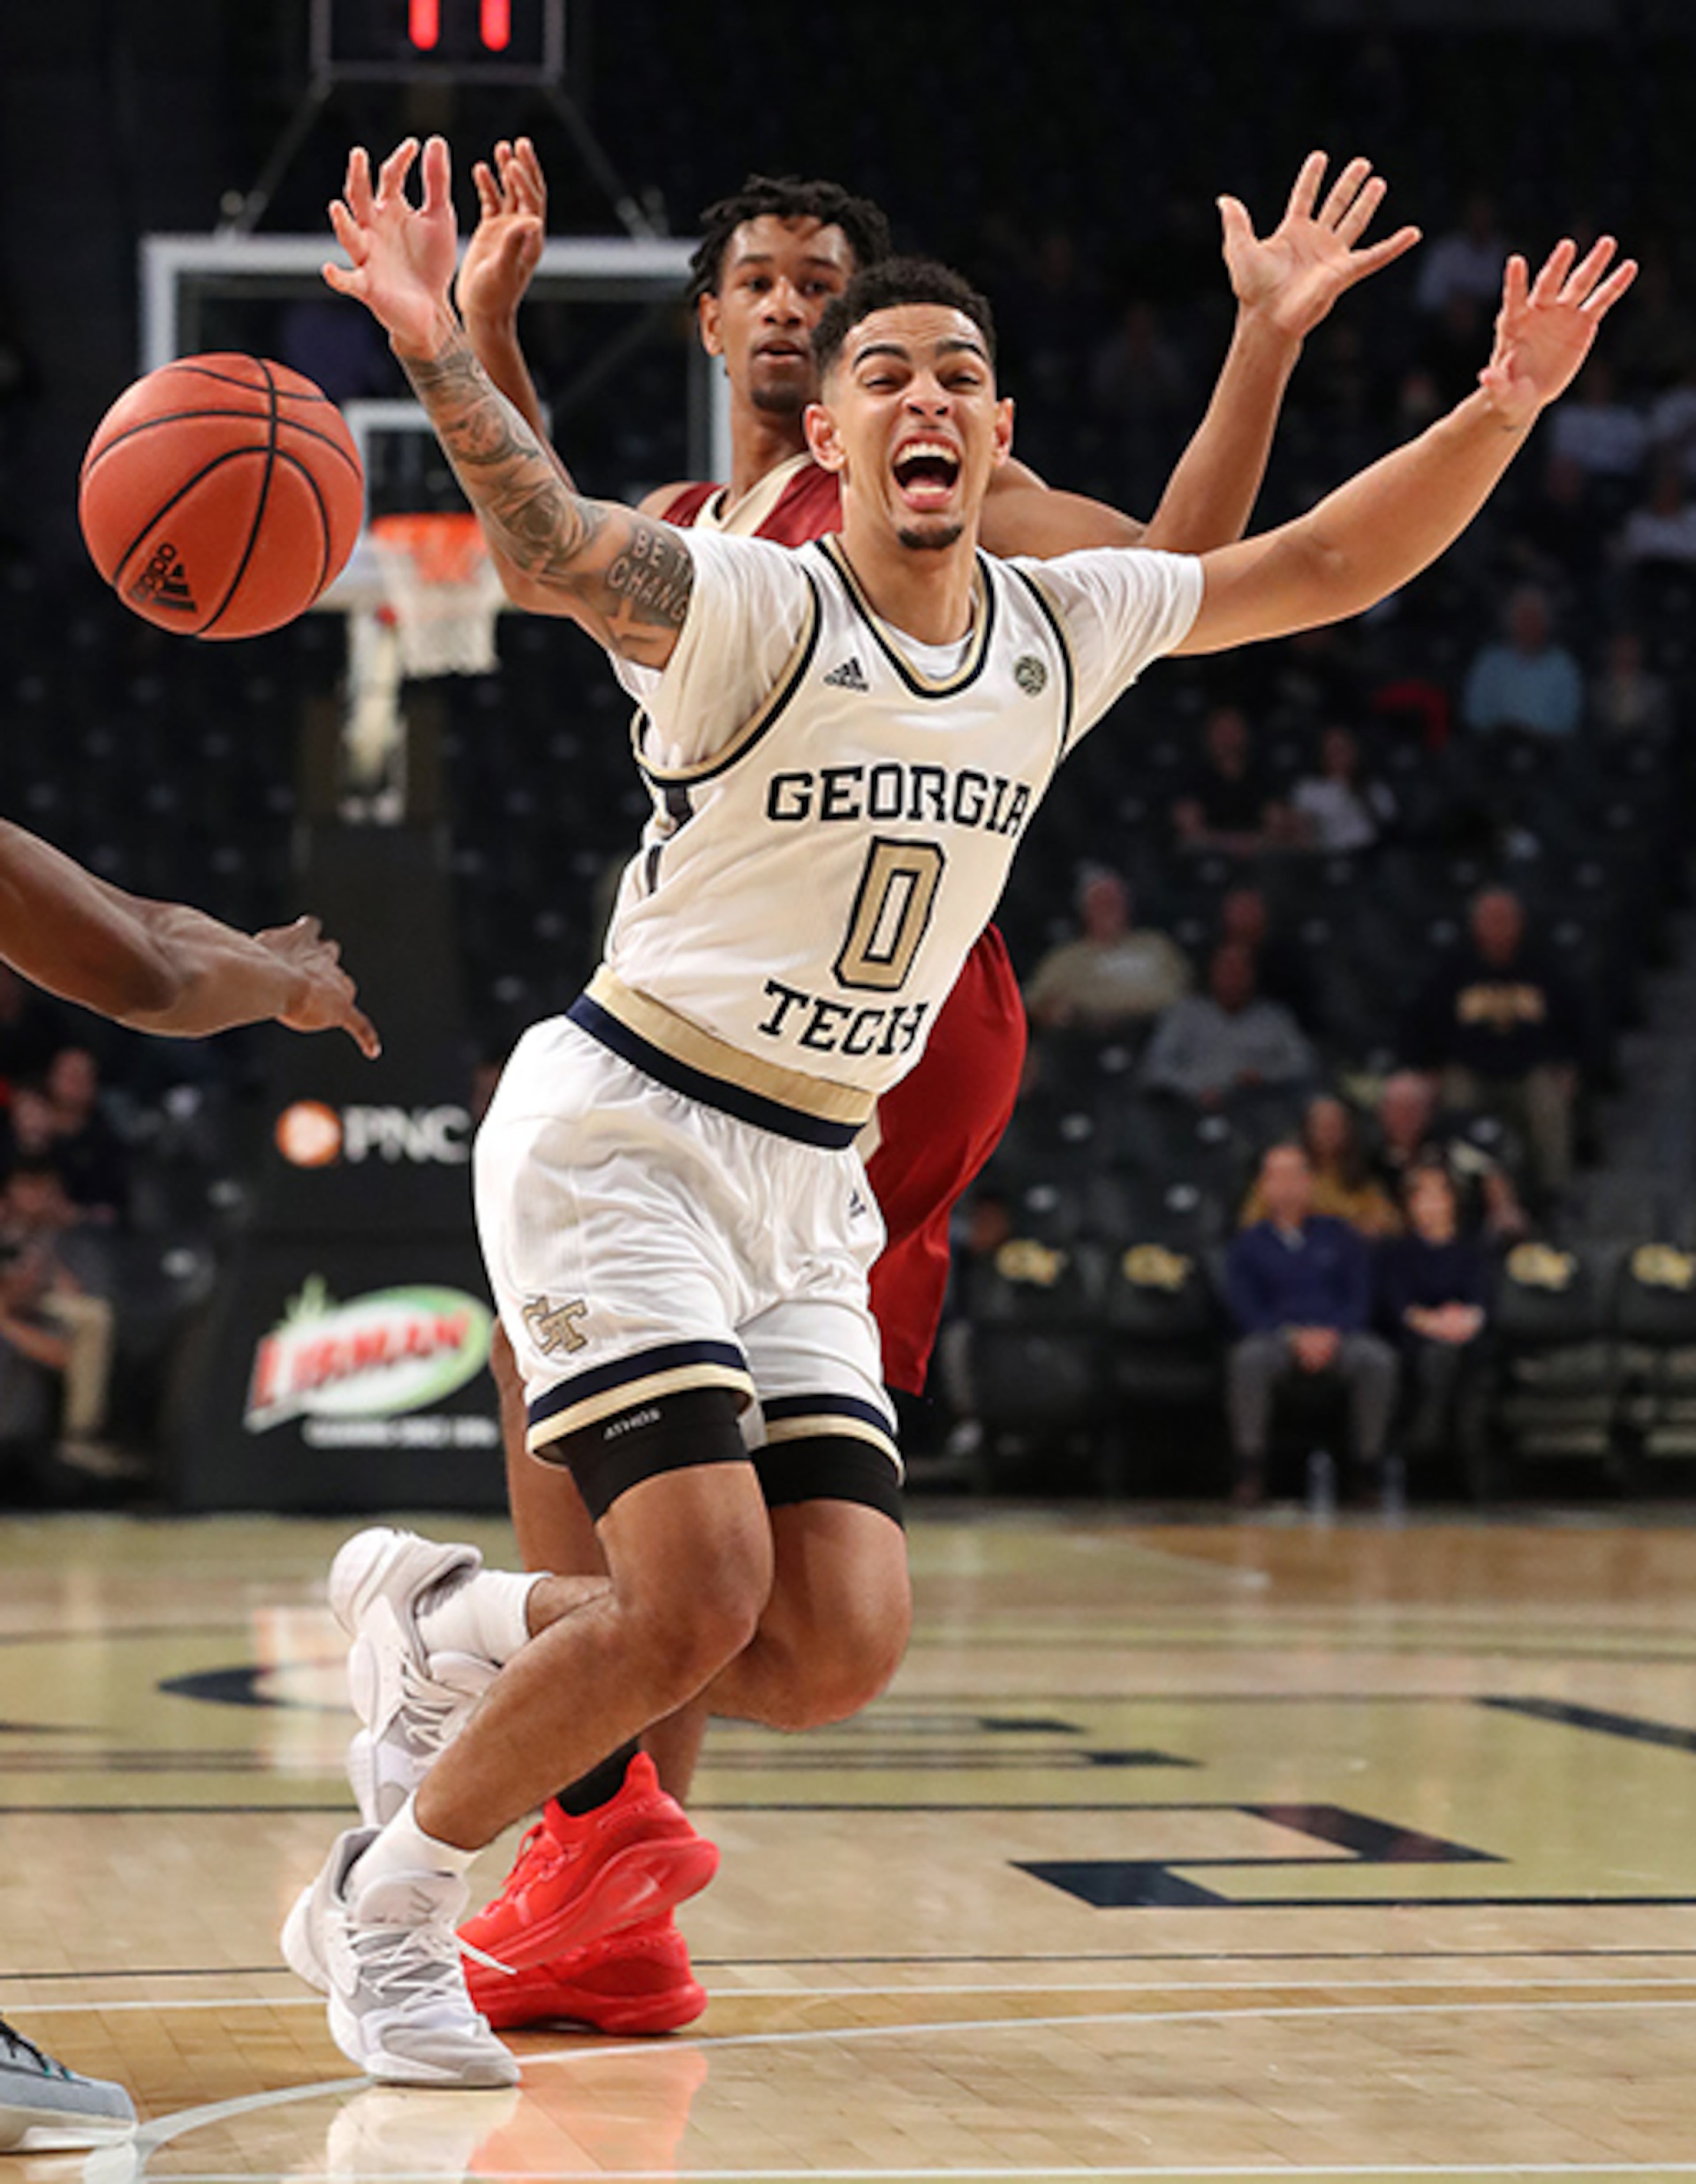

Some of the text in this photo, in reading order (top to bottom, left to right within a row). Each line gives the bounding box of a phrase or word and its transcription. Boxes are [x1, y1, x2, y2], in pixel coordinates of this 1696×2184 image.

[632, 529, 665, 568] BE
[766, 763, 1031, 839] GEORGIA
[832, 835, 946, 992] 0
[757, 979, 929, 1055] TECH
[342, 1104, 472, 1164] PNC
